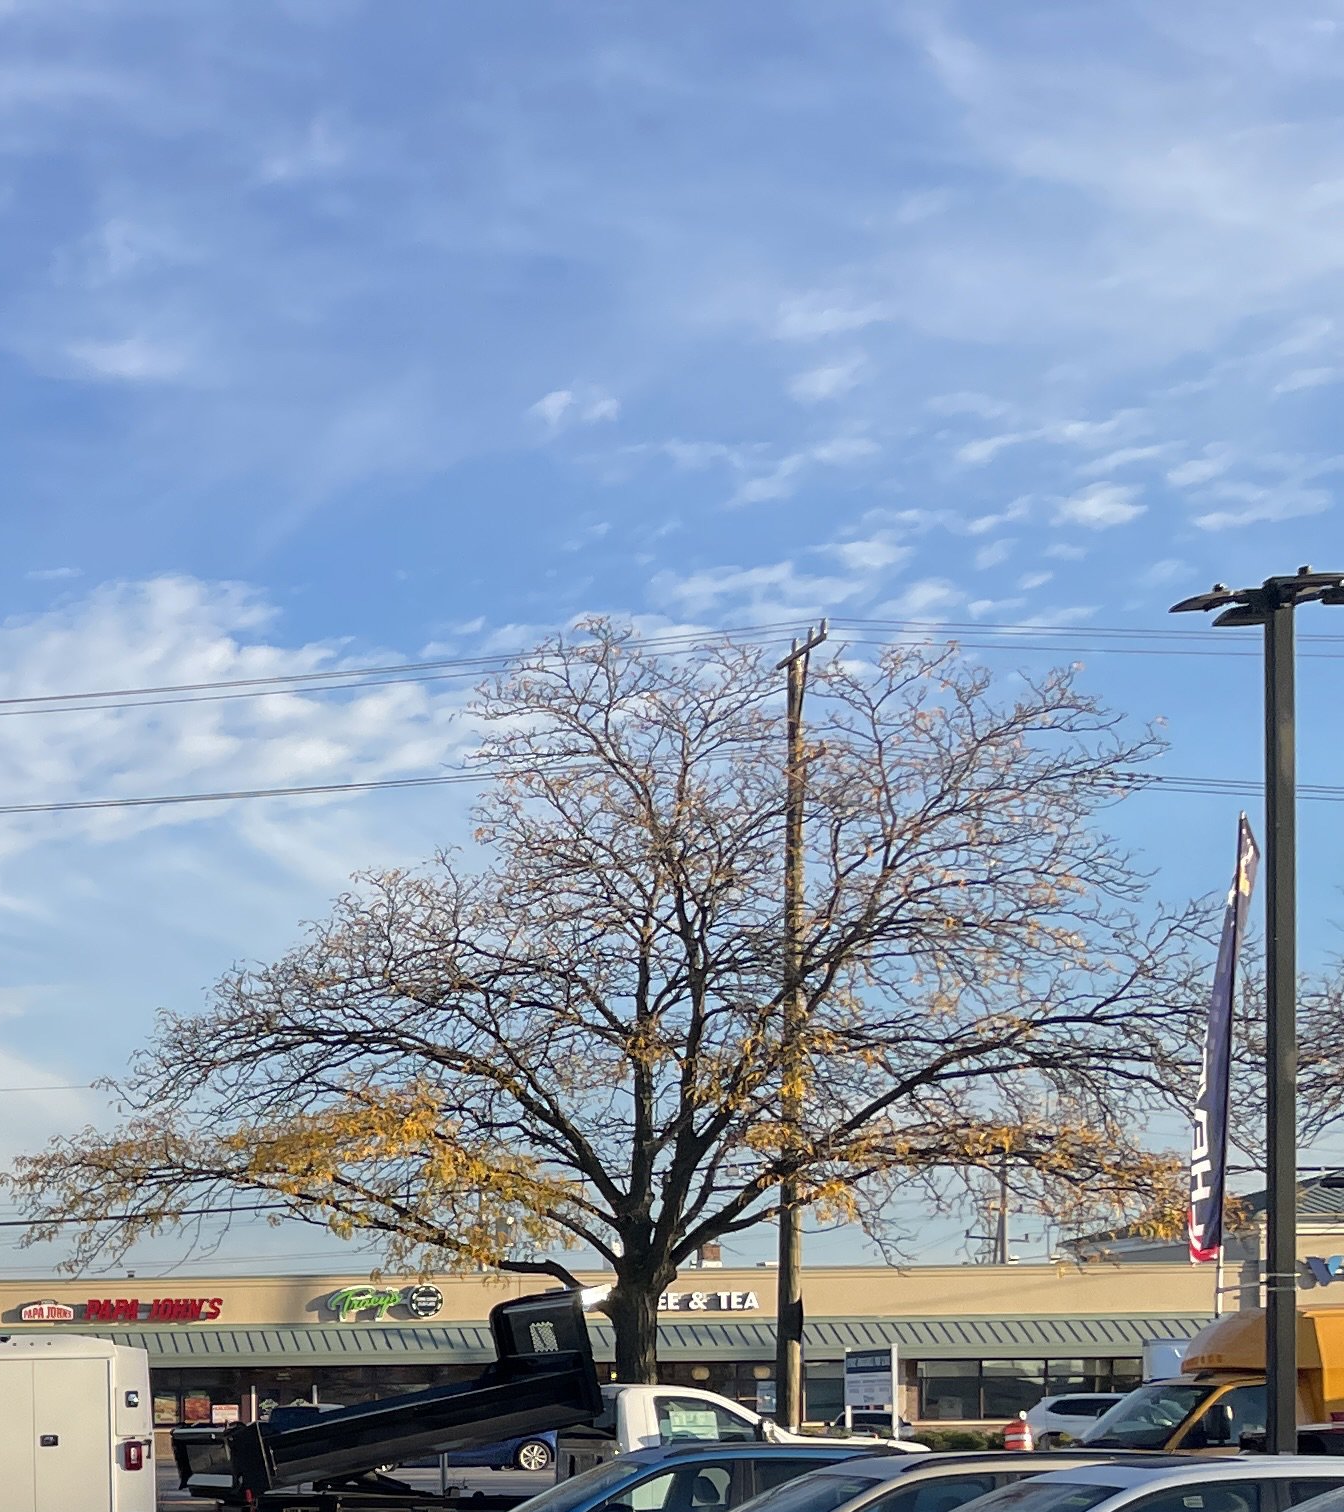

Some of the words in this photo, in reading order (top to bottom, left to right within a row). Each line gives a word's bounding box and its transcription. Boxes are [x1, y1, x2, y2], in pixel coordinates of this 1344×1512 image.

[83, 1299, 140, 1320] PAPA
[147, 1298, 224, 1320] JOHN'S
[688, 1291, 708, 1310] &
[717, 1291, 760, 1310] TEA
[23, 1308, 44, 1319] PAPA
